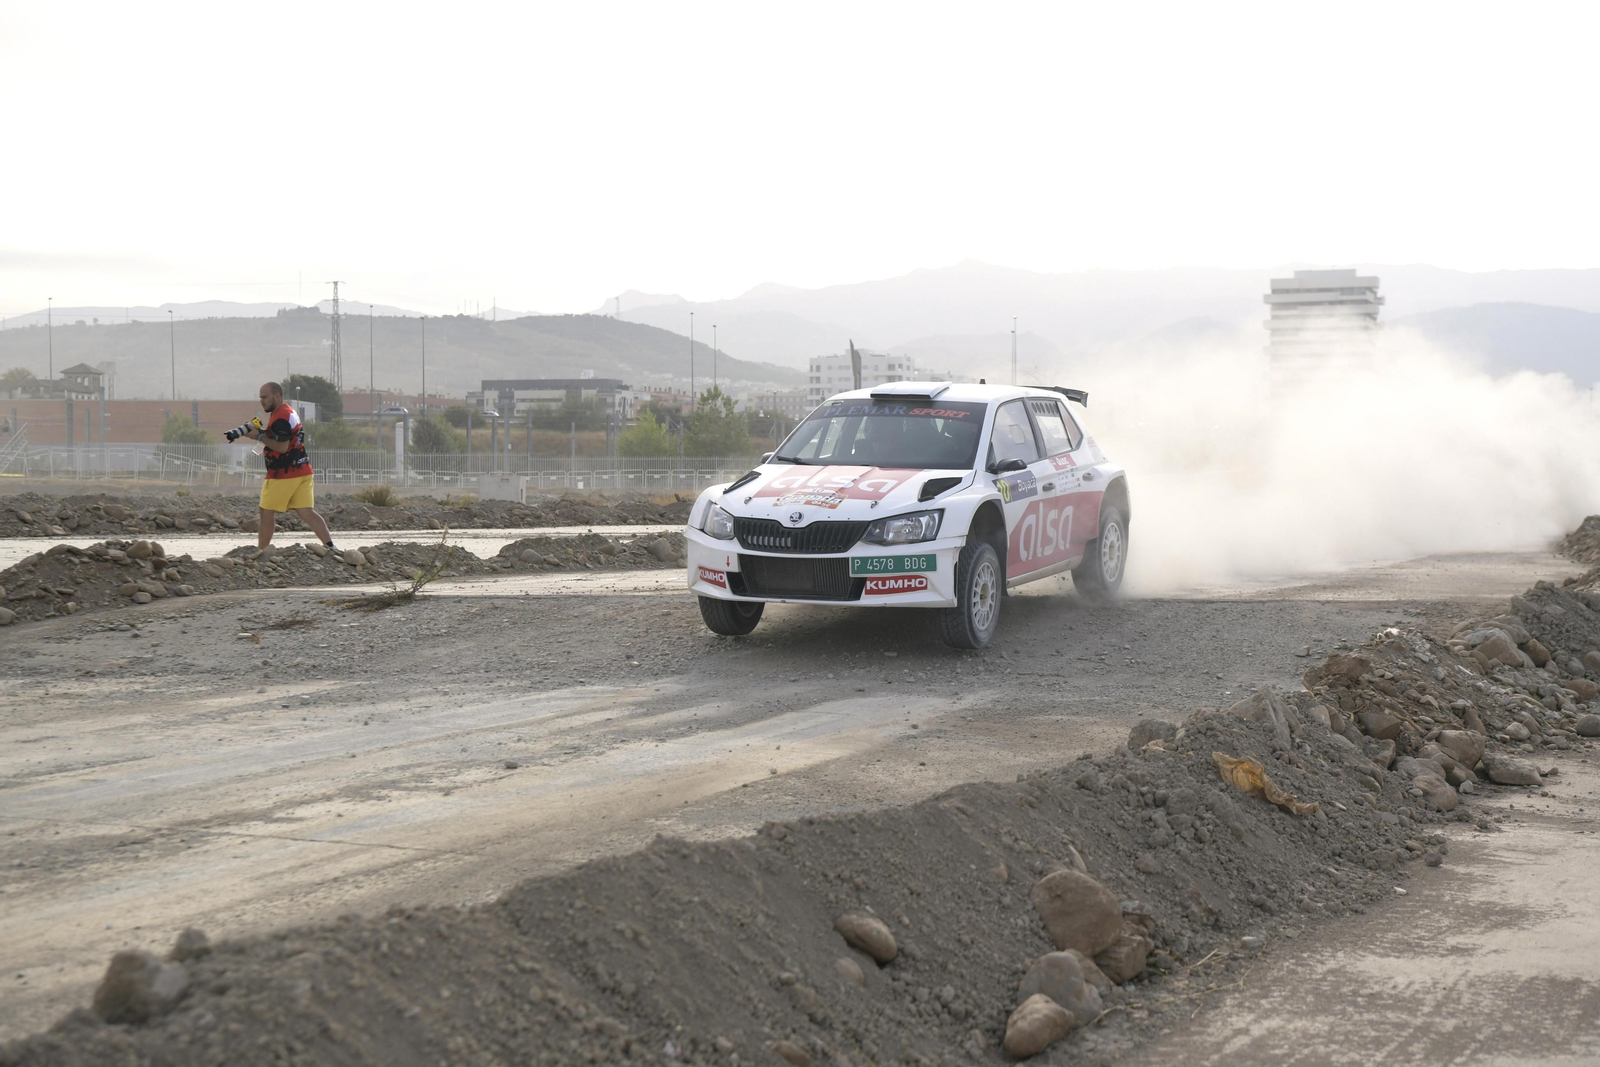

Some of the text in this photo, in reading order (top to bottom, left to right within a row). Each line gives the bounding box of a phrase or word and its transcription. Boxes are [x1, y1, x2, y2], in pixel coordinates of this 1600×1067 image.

[824, 405, 971, 419] PLEMAR SPORT
[771, 472, 899, 494] alsa
[1017, 476, 1037, 493] Boyacá
[1019, 501, 1074, 562] alsa
[853, 557, 928, 571] P 4578 BDG
[698, 569, 726, 584] KUMHO
[865, 577, 928, 591] KUMHO
